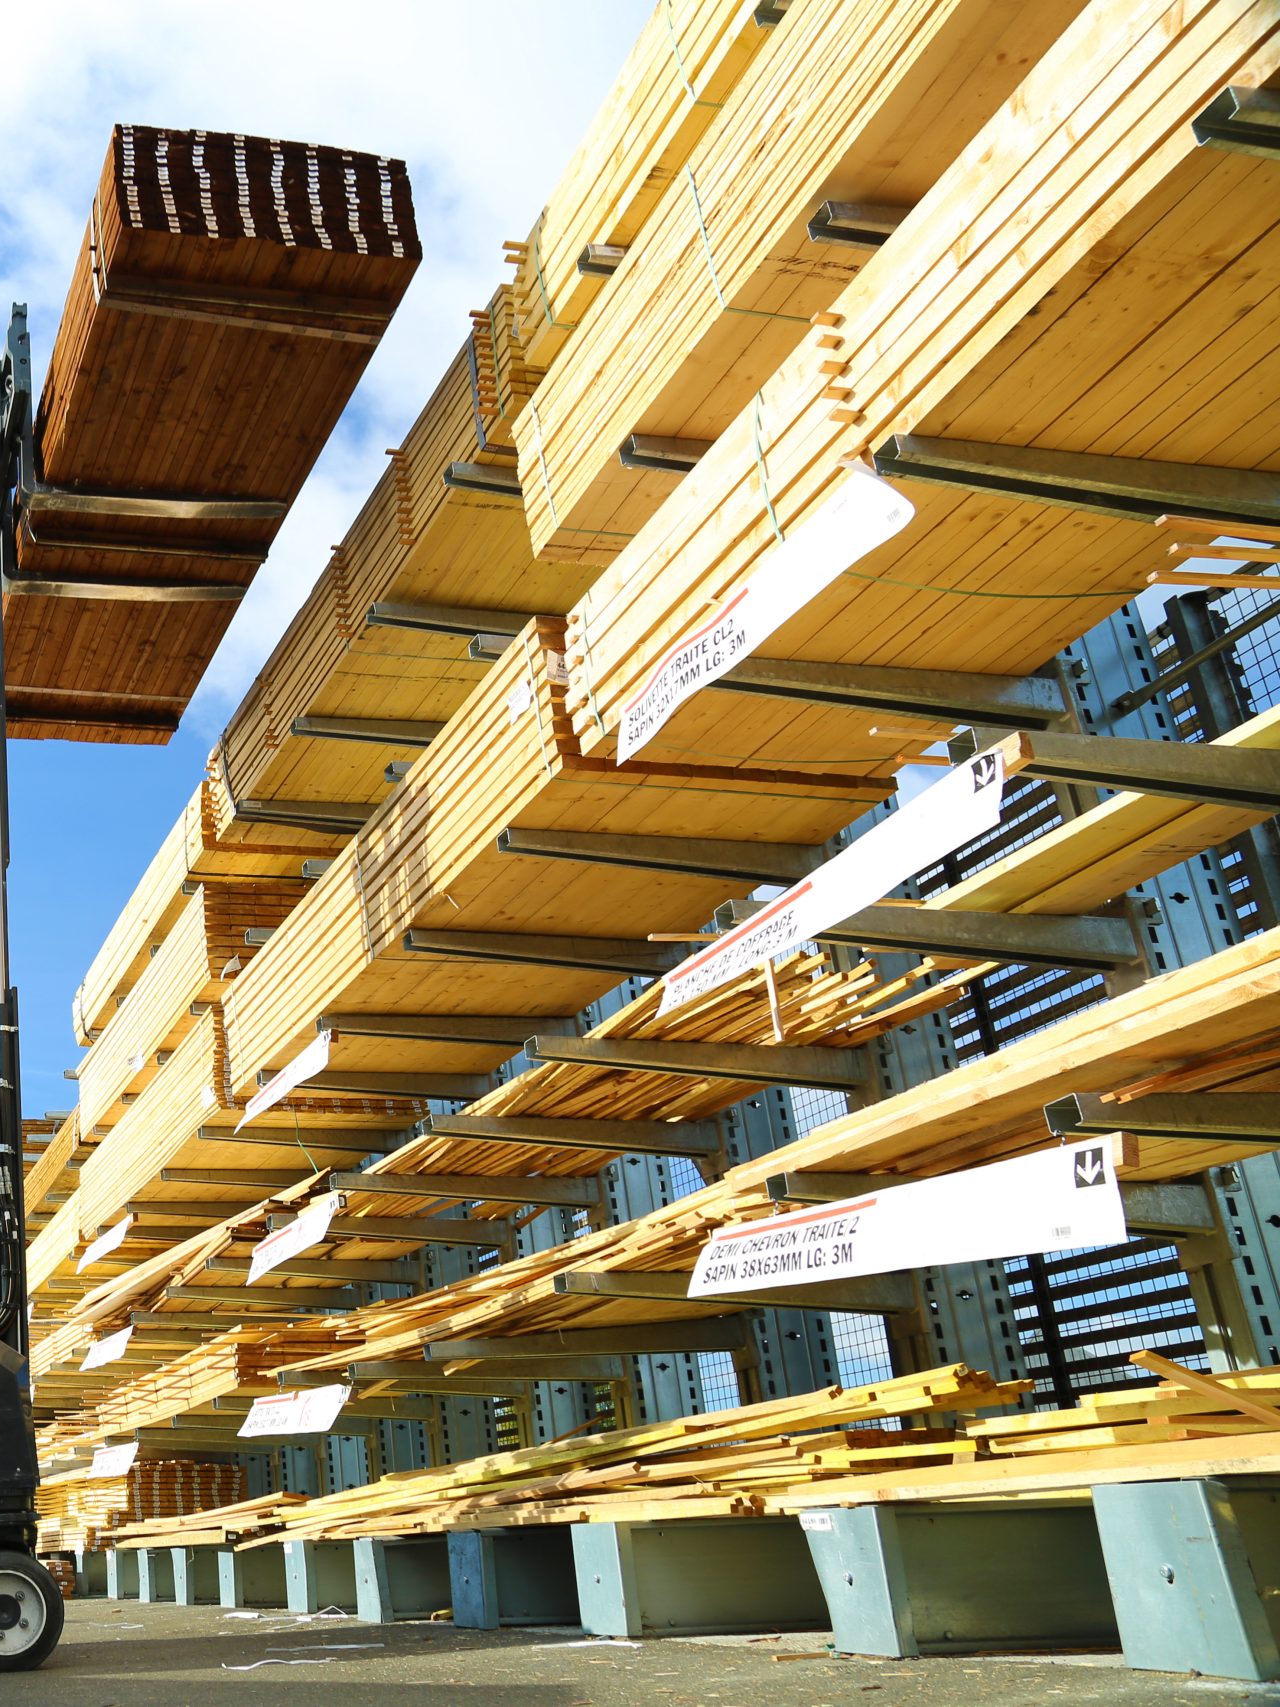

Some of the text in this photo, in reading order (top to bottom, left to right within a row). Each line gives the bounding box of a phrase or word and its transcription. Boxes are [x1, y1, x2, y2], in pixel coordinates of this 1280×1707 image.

[627, 712, 654, 746] SAPIN
[705, 651, 725, 673] LG:
[729, 629, 746, 656] 3M
[628, 618, 734, 727] SOLIVETTE TRAITE CL2
[673, 909, 795, 993] PLANCHE DE COFFRAGE
[703, 1242, 854, 1284] SAPIN 38X63MM LG: 3M
[710, 1242, 739, 1261] DEMI
[742, 1229, 799, 1254] CHEVRON
